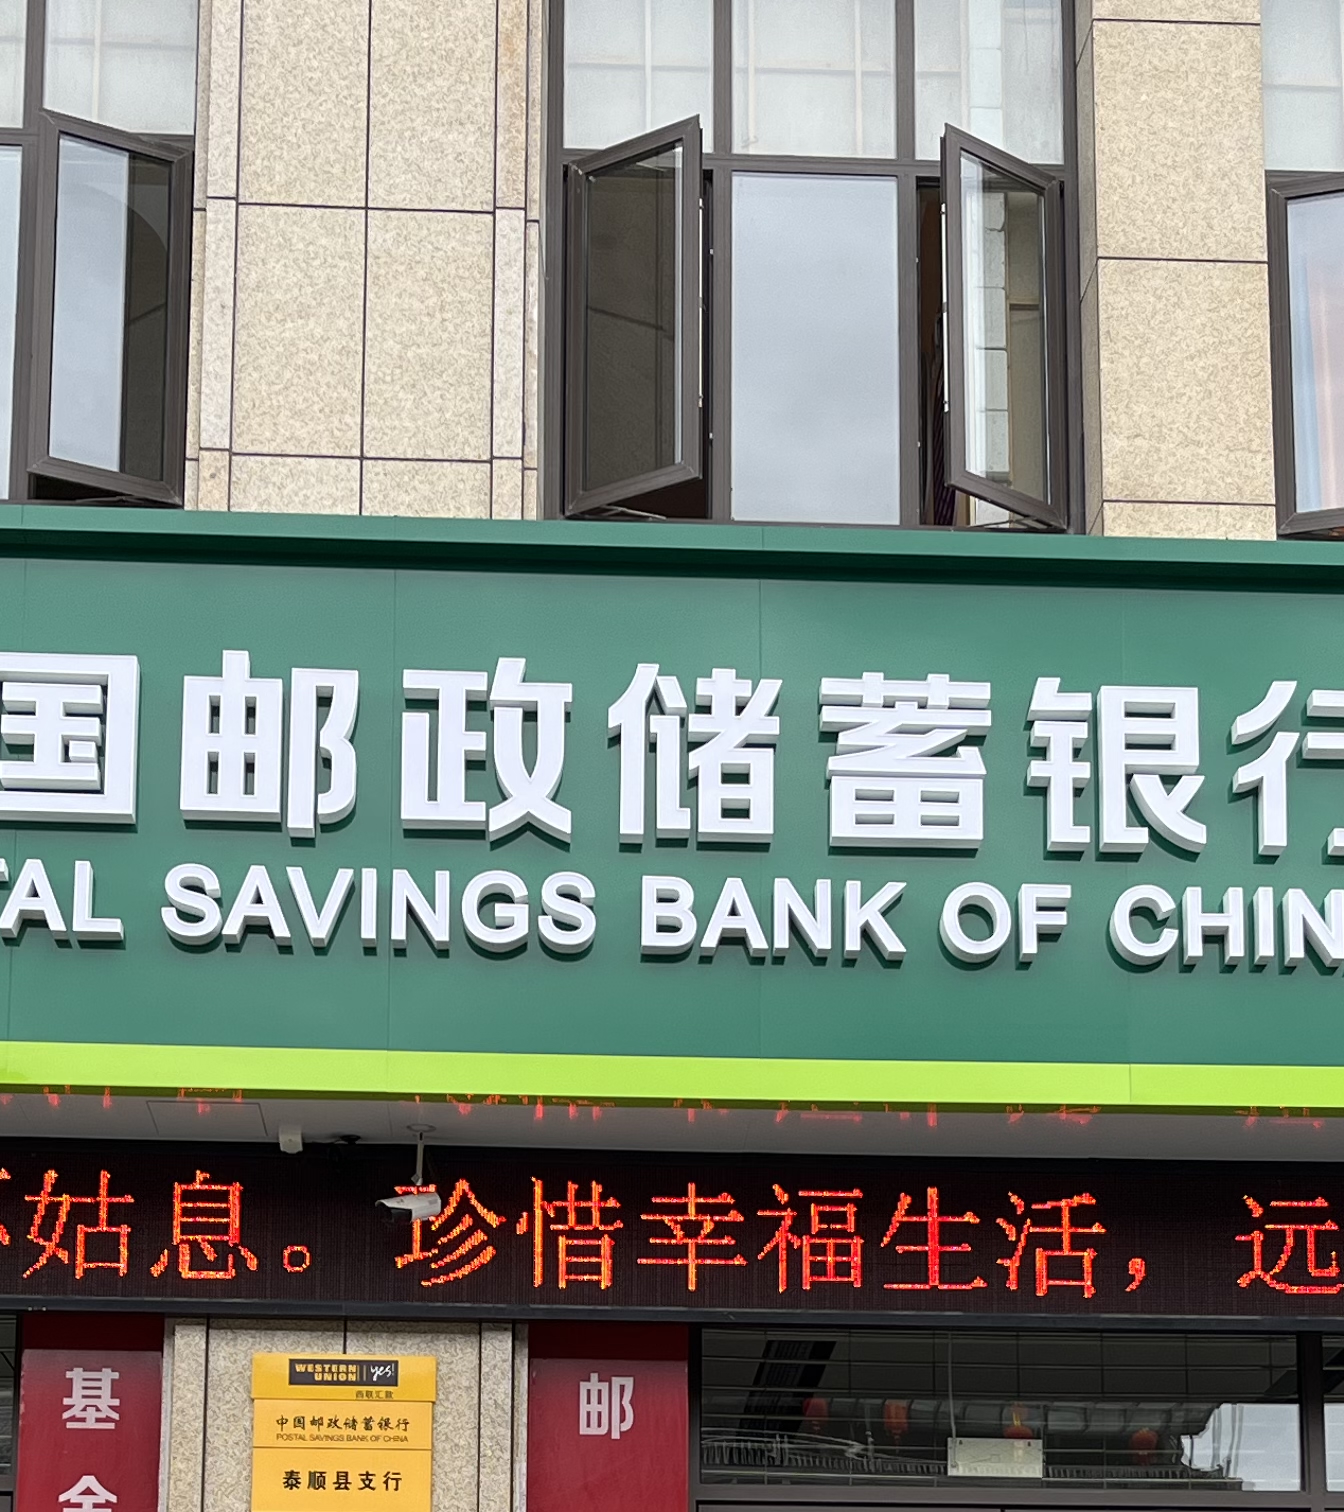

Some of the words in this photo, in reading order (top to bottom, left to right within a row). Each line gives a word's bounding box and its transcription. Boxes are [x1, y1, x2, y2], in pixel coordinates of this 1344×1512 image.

[162, 863, 596, 954] SAVINGS
[640, 875, 906, 961] BANK
[940, 881, 1072, 964] OF
[294, 1363, 356, 1373] WESTERN
[314, 1372, 356, 1381] UNION
[276, 1415, 410, 1432] 中国邮政储蓄银行
[276, 1433, 306, 1441] POSTAL
[310, 1434, 344, 1442] SAVINGS
[346, 1434, 368, 1442] BANK
[282, 1470, 402, 1491] 泰顺县支行
